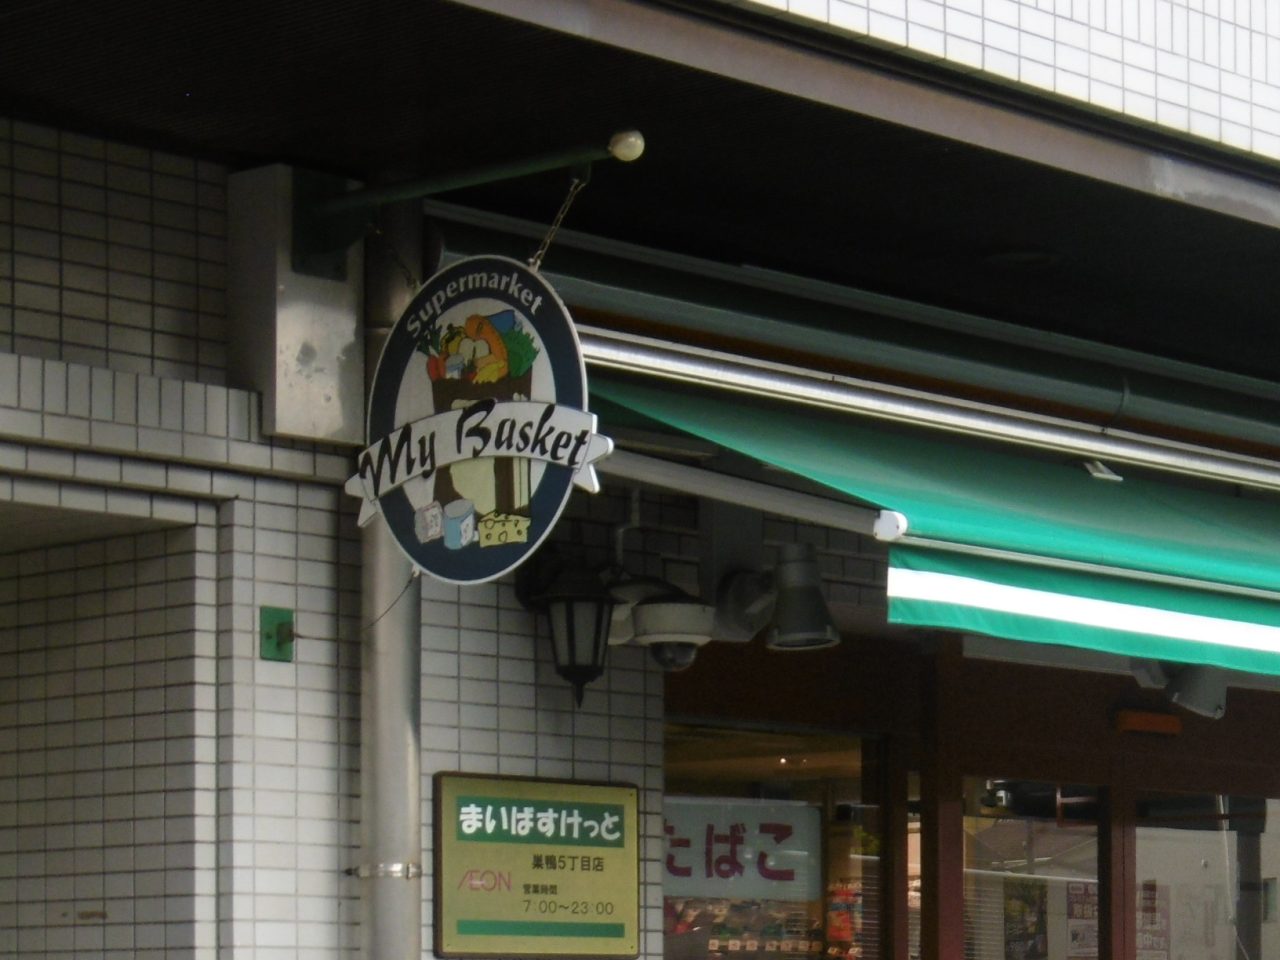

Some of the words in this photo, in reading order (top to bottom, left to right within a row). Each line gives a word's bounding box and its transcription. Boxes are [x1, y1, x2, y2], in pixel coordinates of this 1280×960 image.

[406, 271, 543, 338] Supermarket
[358, 422, 436, 497] My
[456, 399, 590, 469] Basket
[459, 803, 621, 840] まいばすけっと
[532, 853, 605, 872] 巣鴨5丁目店
